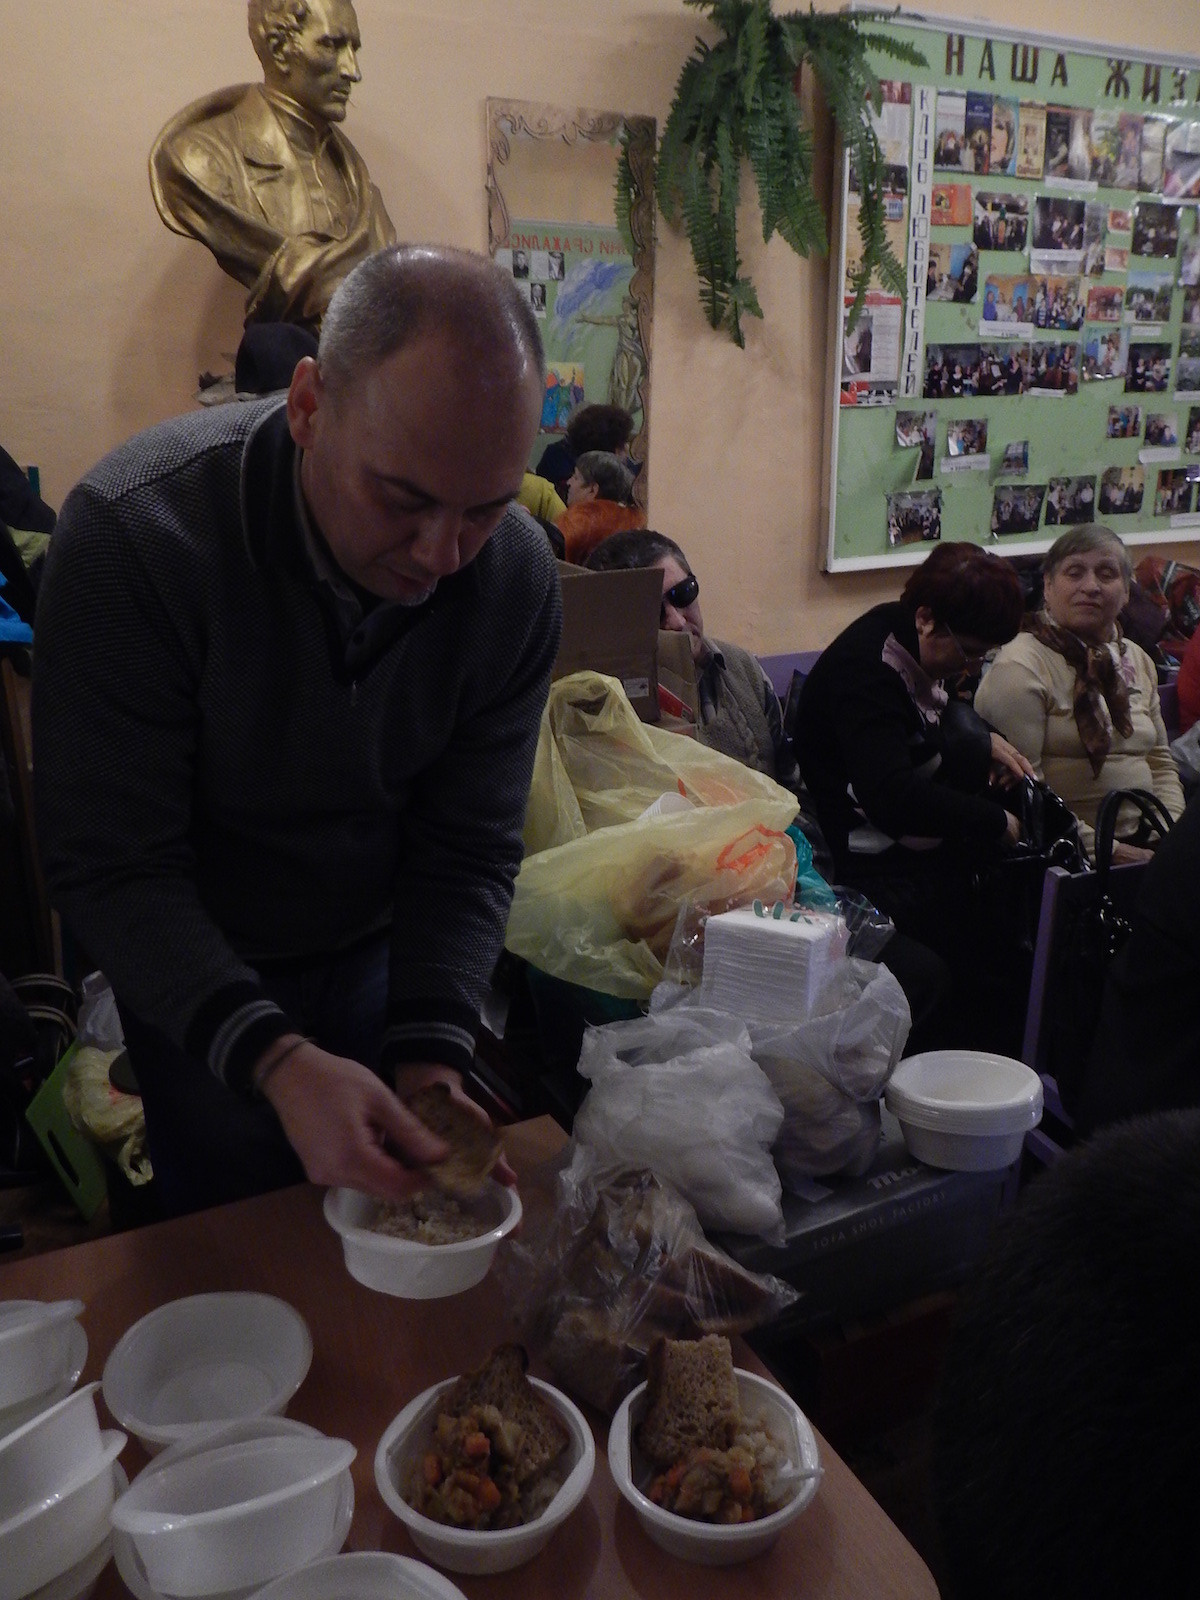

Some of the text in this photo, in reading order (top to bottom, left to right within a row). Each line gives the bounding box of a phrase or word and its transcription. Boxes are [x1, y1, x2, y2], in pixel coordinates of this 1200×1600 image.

[945, 32, 1200, 105] НАША ЖИЗ
[917, 88, 930, 184] КЛУБ
[852, 1215, 884, 1235] SHOE
[892, 1190, 946, 1218] FACTORY
